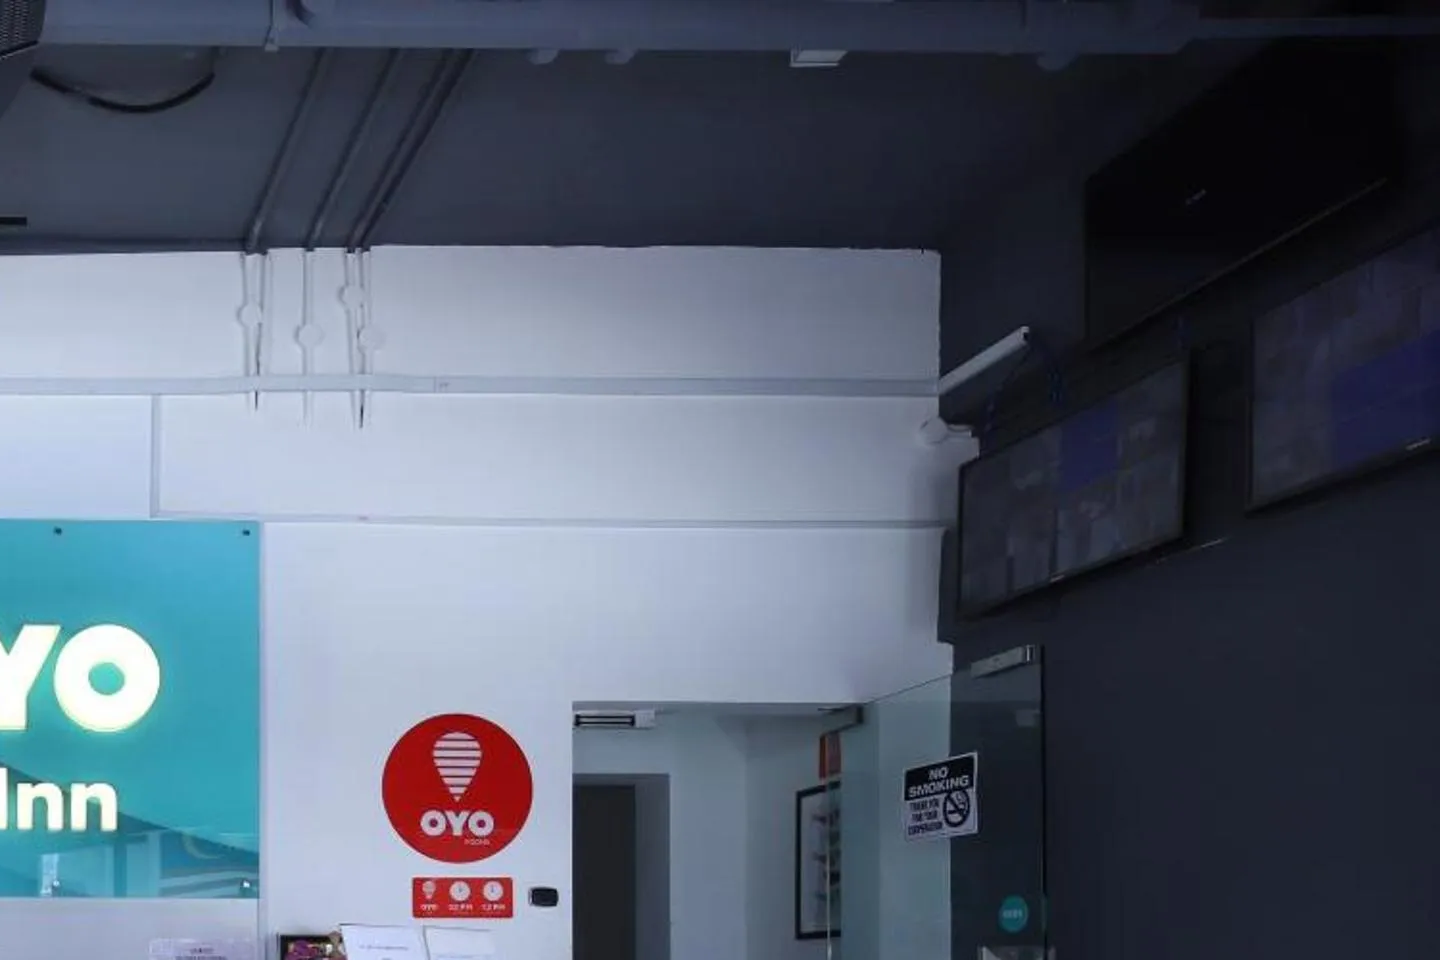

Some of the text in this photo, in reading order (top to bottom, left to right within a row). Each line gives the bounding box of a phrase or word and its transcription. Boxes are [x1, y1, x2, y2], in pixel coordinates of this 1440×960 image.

[928, 766, 949, 781] NO
[909, 774, 970, 798] SMOKING
[420, 809, 495, 836] OYO
